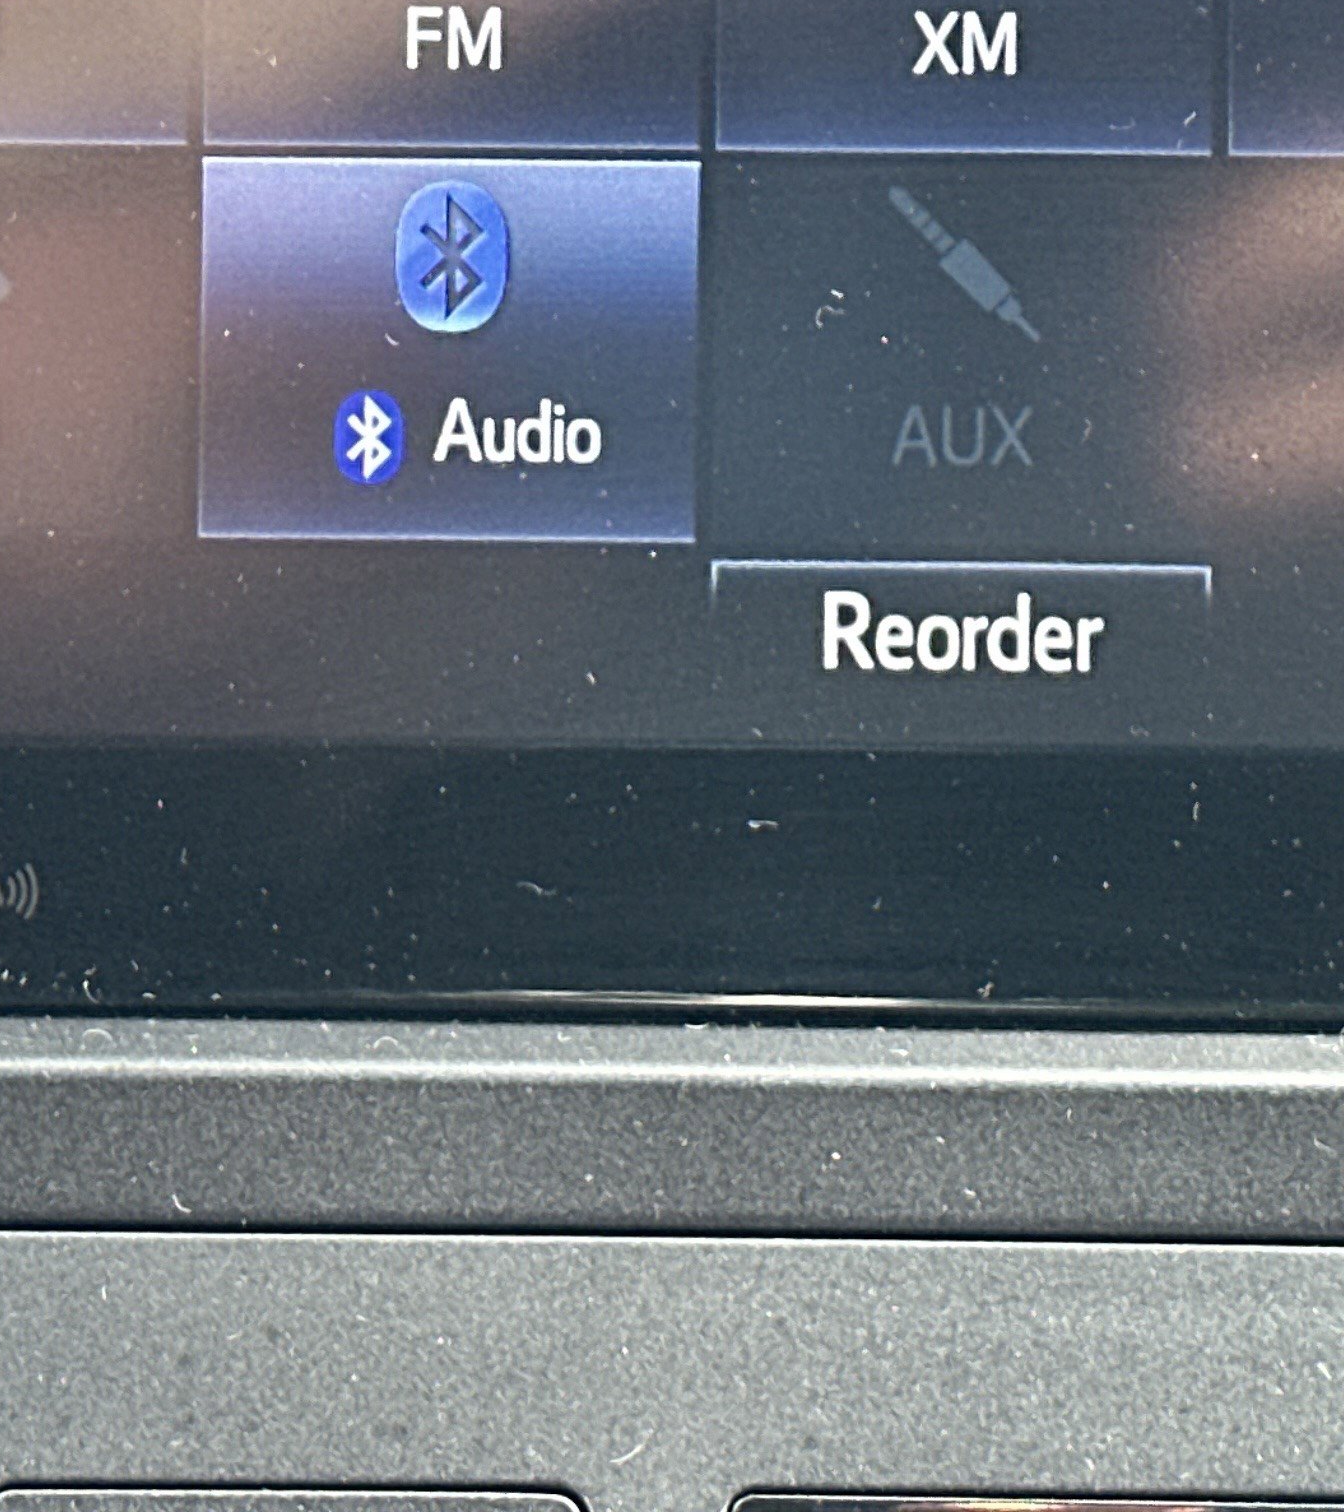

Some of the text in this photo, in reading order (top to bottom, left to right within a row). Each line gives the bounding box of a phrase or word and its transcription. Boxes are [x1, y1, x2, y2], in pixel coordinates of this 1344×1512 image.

[406, 7, 501, 71] FM
[912, 11, 1017, 76] XM
[433, 398, 601, 465] Audio
[892, 406, 1033, 467] AUX
[822, 590, 1104, 672] Reorder
